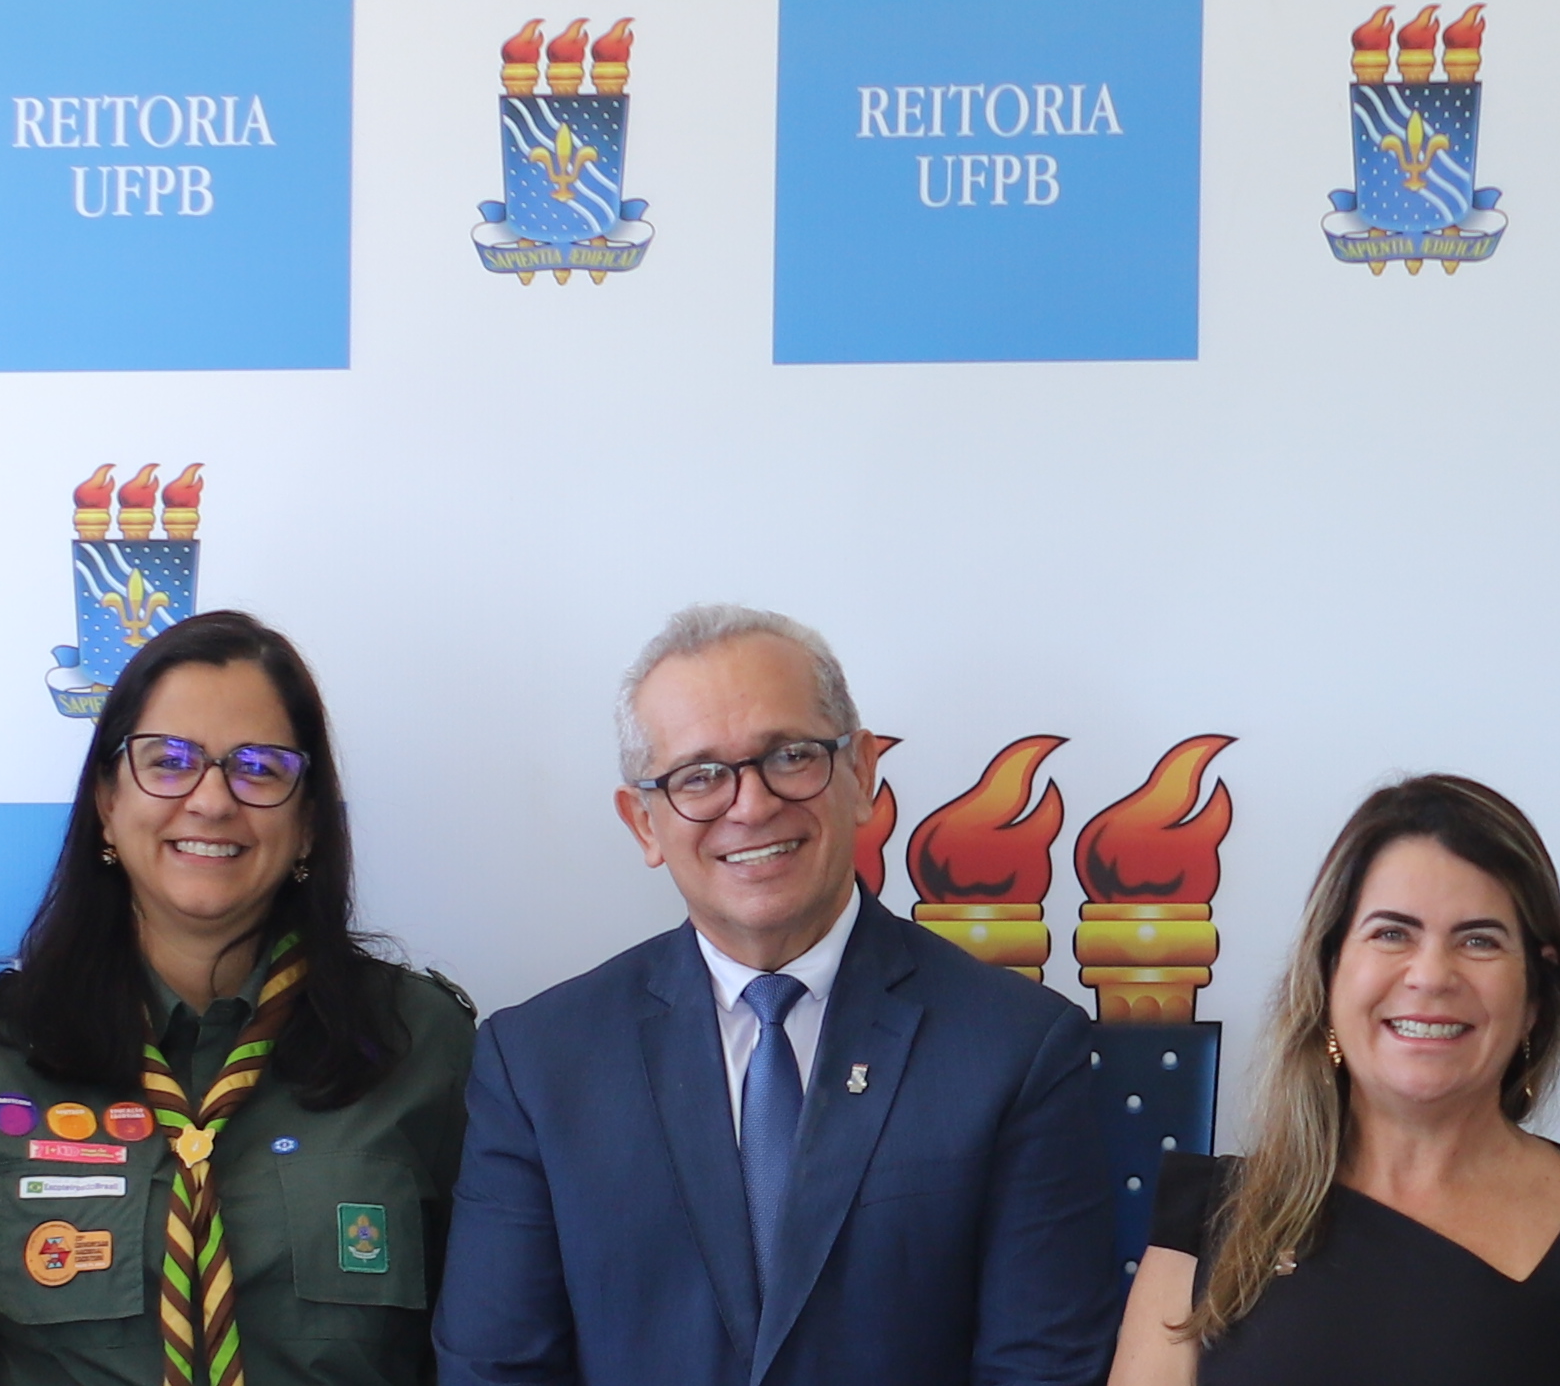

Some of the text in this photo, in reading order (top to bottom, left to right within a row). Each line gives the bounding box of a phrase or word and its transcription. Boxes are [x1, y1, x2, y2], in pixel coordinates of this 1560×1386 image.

[11, 94, 277, 148] REITORIA
[856, 82, 1124, 138] REITORIA
[70, 165, 214, 218] UFPB
[915, 154, 1060, 207] UFPB
